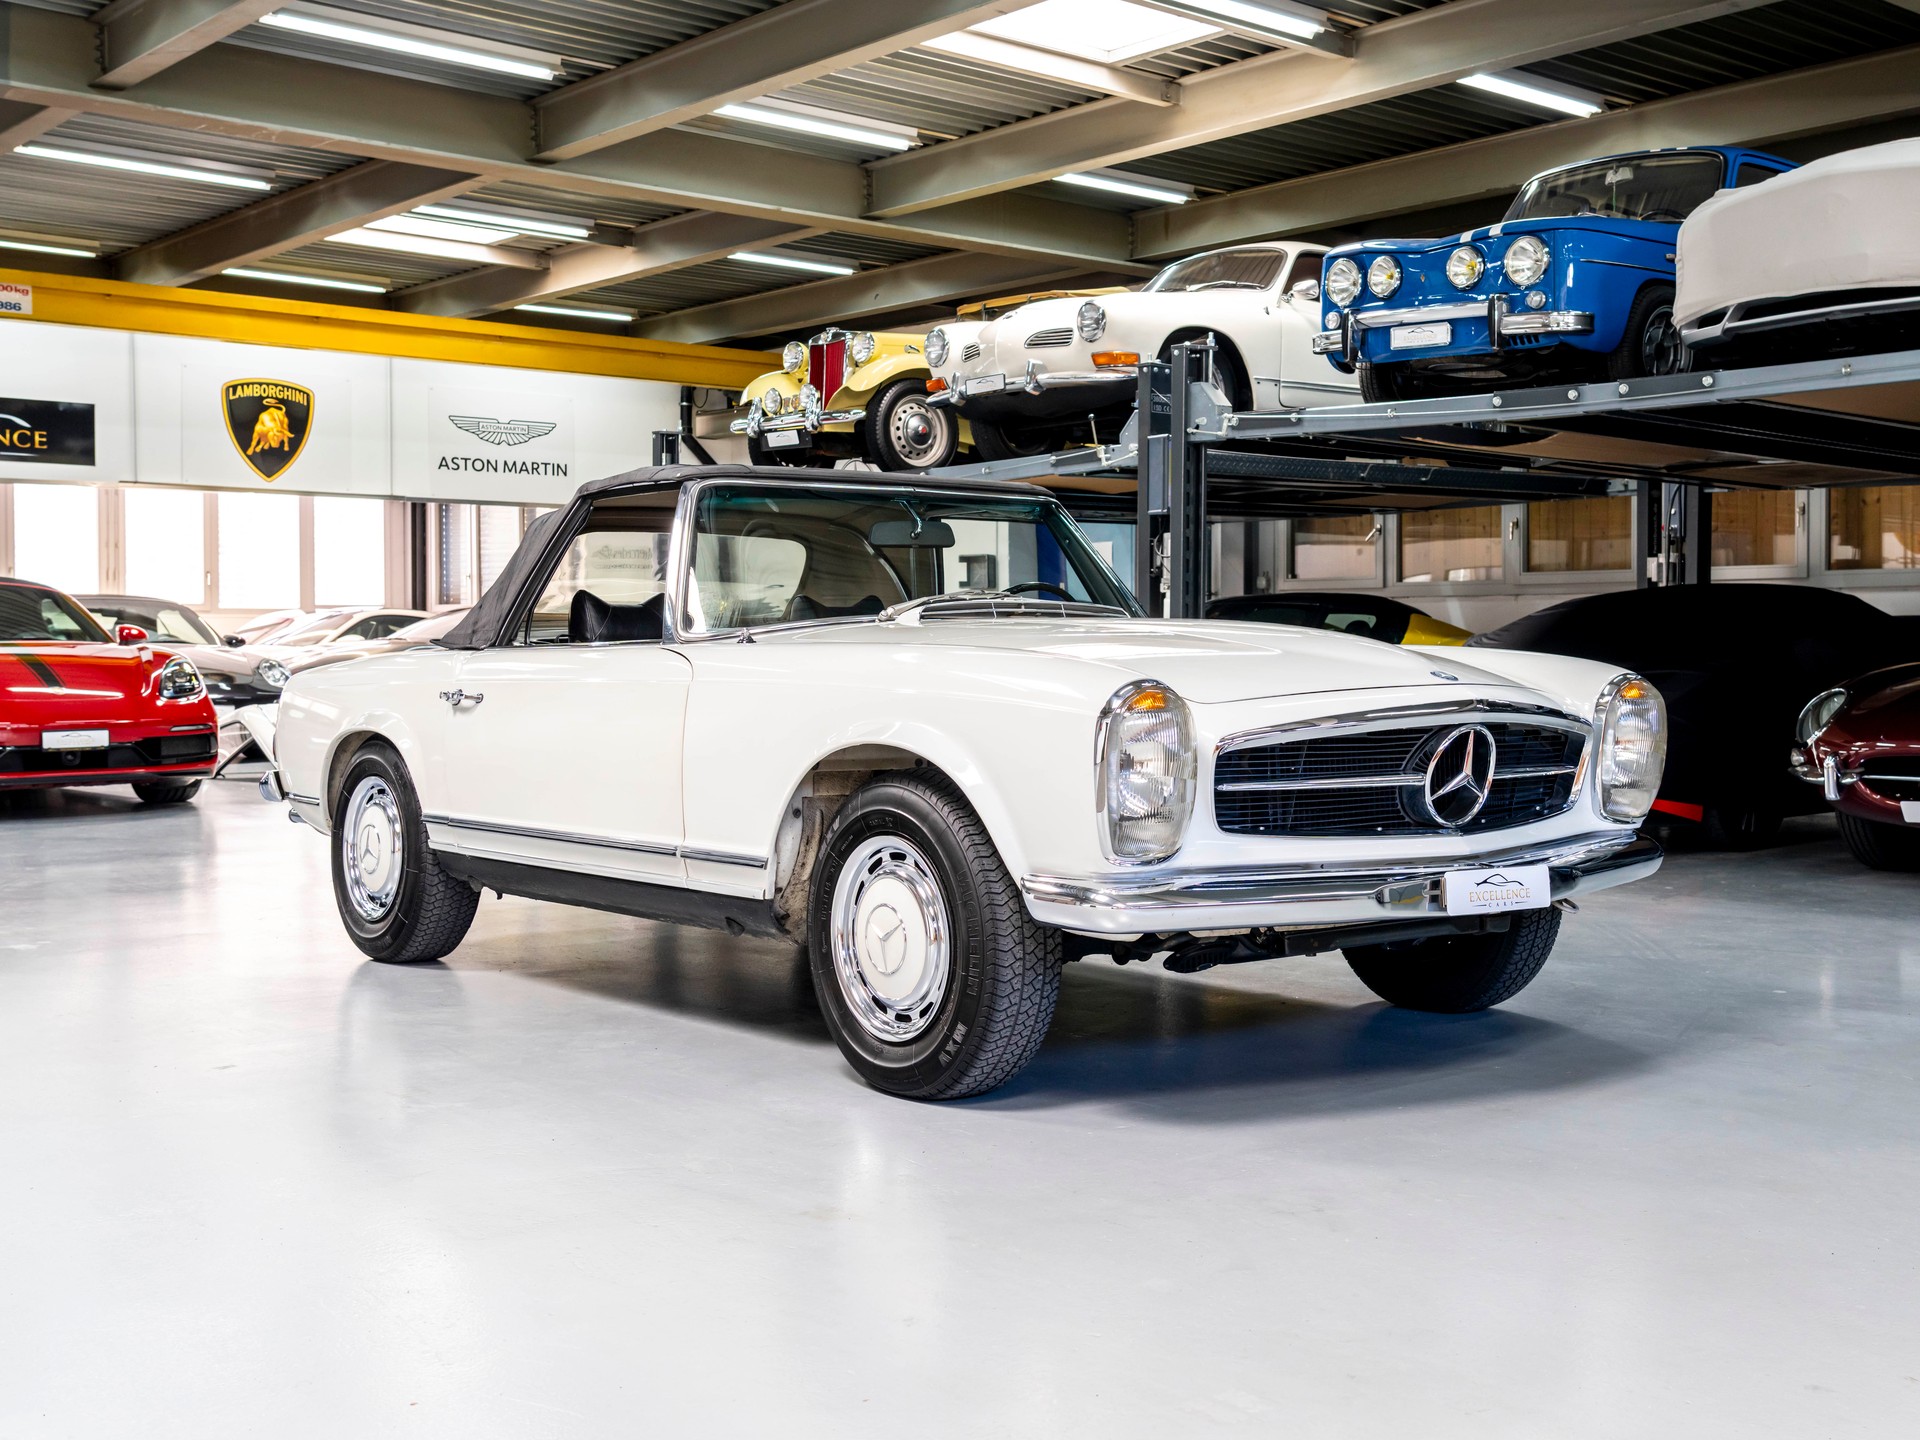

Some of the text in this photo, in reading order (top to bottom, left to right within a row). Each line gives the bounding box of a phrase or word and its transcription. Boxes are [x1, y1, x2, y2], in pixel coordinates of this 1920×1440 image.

[229, 384, 307, 406] LAMBORGHINI
[438, 456, 568, 477] ASTON MARTIN
[1469, 887, 1531, 903] EXCELLENCE
[956, 869, 981, 996] MICHELIN
